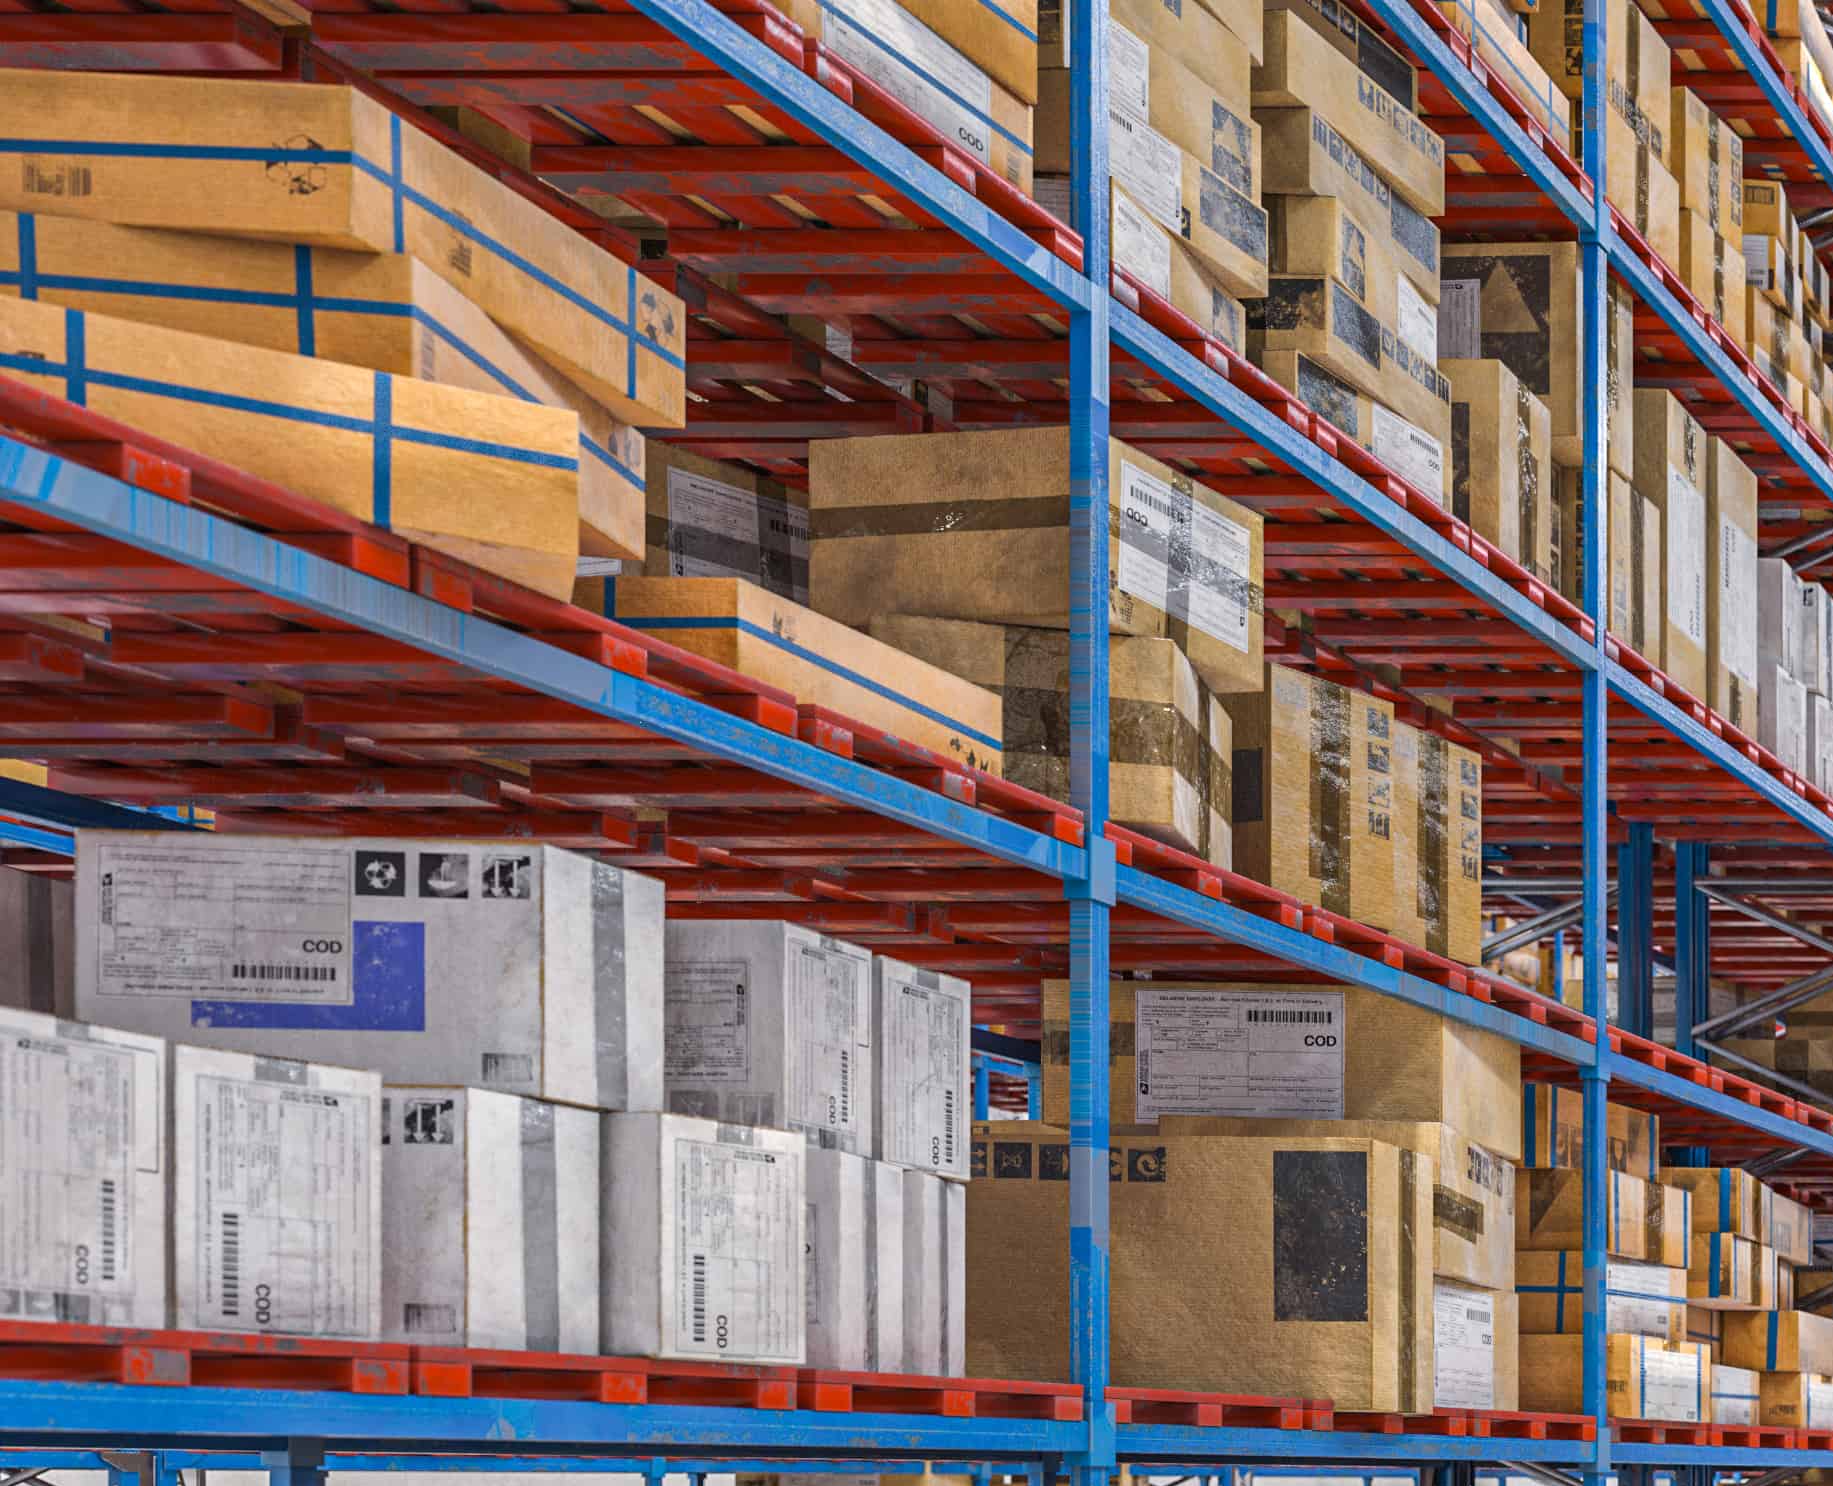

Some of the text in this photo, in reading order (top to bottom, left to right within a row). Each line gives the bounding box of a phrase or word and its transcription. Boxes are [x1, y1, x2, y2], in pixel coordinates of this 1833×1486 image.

[959, 127, 984, 152] COD
[302, 939, 343, 954] COD
[1304, 1034, 1336, 1047] COD
[829, 1095, 837, 1125] COD
[932, 1136, 940, 1165] COD
[75, 1244, 89, 1285] COD
[255, 1283, 271, 1324] COD
[716, 1314, 728, 1348] COD
